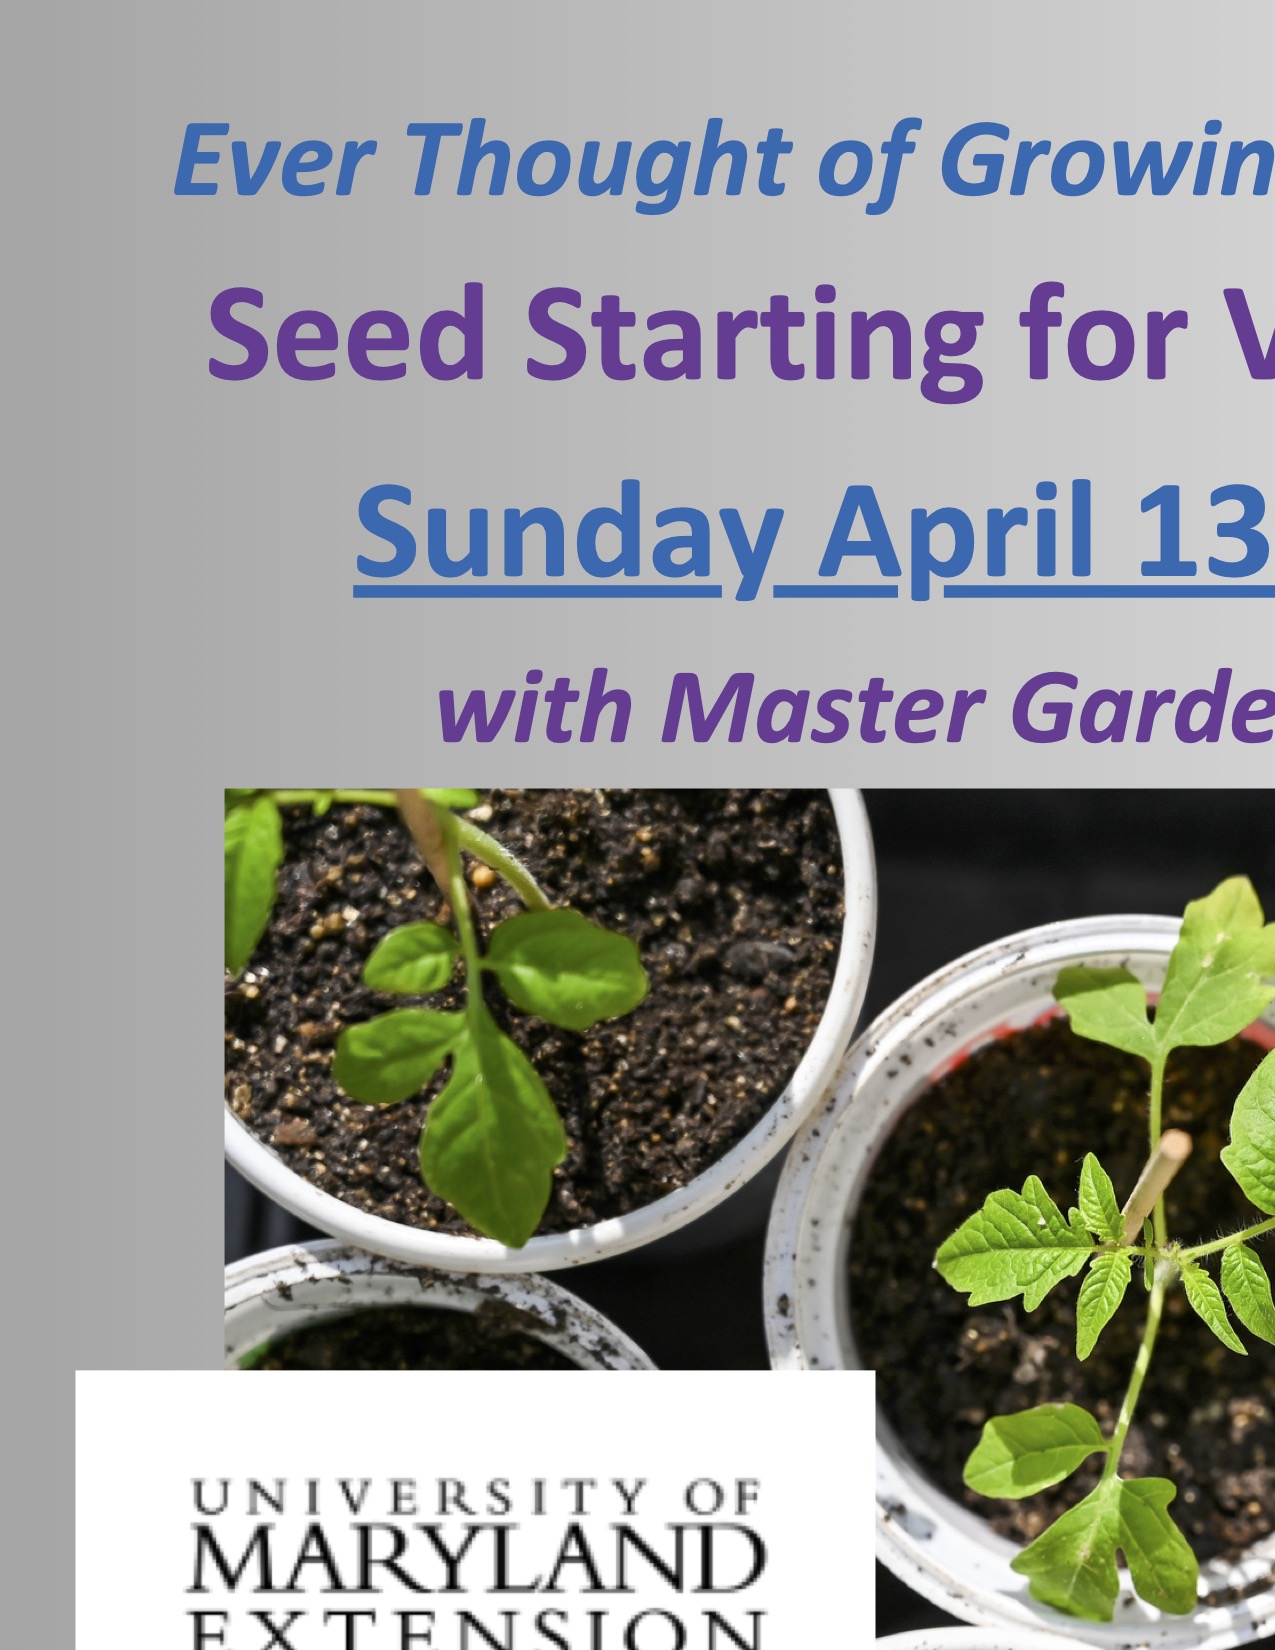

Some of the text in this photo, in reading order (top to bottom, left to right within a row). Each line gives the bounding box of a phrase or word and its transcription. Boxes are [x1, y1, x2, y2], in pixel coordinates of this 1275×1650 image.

[174, 123, 377, 196] Ever
[407, 118, 793, 215] Thought
[819, 117, 922, 215] of
[209, 282, 483, 381] Seed
[527, 284, 984, 404] Starting
[1019, 281, 1188, 381] for
[357, 479, 784, 600] Sunday
[818, 479, 1091, 600] April
[439, 668, 631, 743] with
[662, 673, 987, 743] Master
[194, 1478, 759, 1515] UNIVERSITY OF
[186, 1522, 768, 1593] MARYLAND
